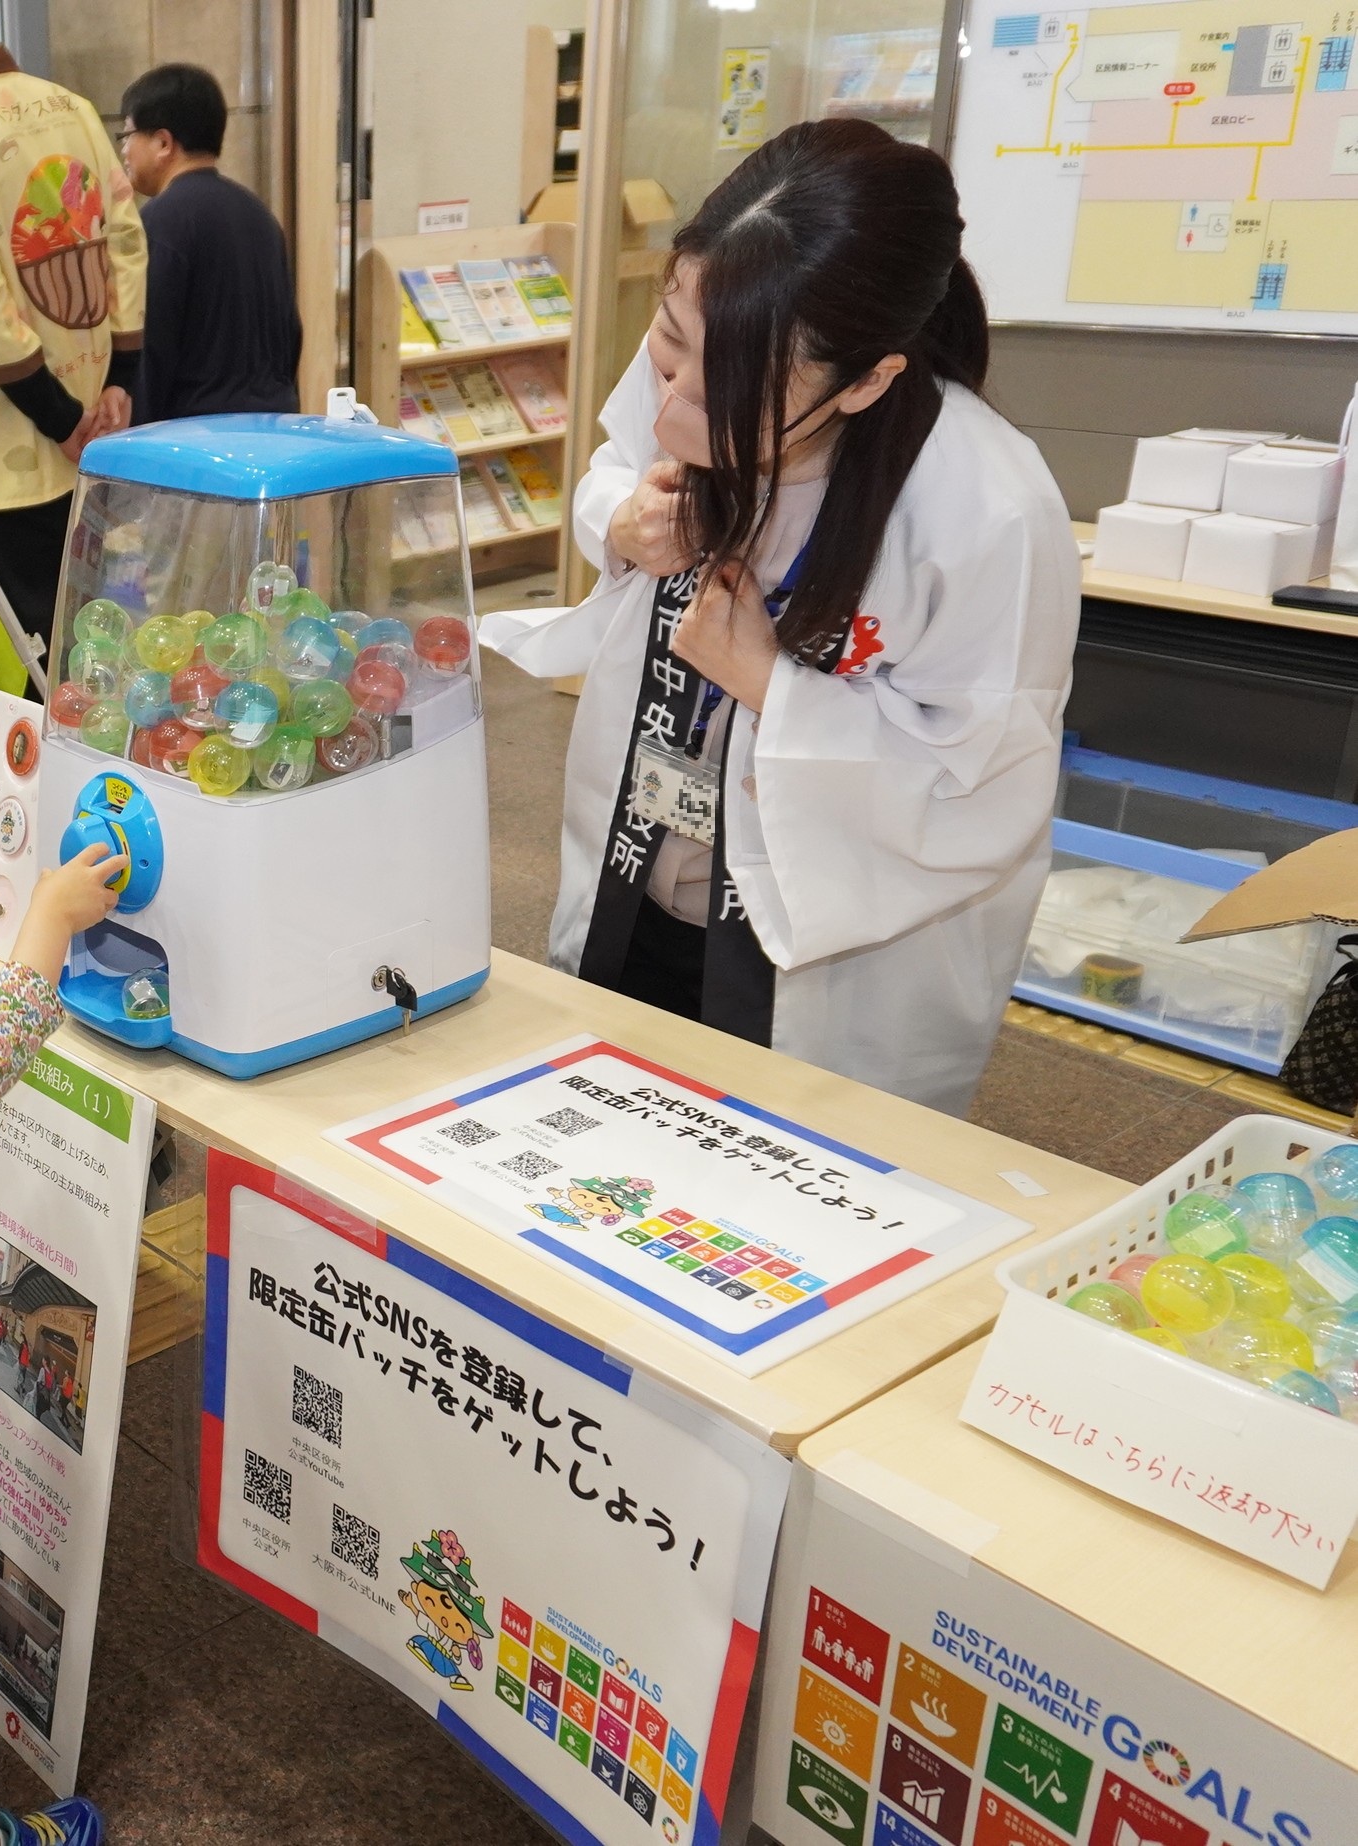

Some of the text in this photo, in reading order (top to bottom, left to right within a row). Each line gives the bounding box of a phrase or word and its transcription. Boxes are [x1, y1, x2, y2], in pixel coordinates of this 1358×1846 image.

[1095, 62, 1160, 73] 区民情報コーナー
[1190, 62, 1217, 72] 区役所
[1211, 115, 1255, 126] 区民ロビー
[558, 1073, 904, 1232] 限定缶バッチをゲットしよう！
[631, 1085, 850, 1193] 公式SNSを登録して、
[755, 1236, 806, 1264] GOALS
[313, 1261, 613, 1467] 公式SNSを登録して、
[249, 1266, 706, 1572] 限定缶バッチをゲットしよう！
[288, 1447, 345, 1489] 公式YouTube
[292, 1436, 341, 1474] 中央区役所
[988, 1383, 1336, 1553] カプセルはこちらに返却下さい
[242, 1517, 291, 1553] 中央区役所
[253, 1536, 279, 1559] 公式X
[311, 1552, 397, 1616] 大阪市公式LINE
[813, 1595, 820, 1611] 1
[547, 1606, 603, 1650] SUSTAINABLE
[546, 1614, 663, 1704] DEVELOPMENT GOALS
[903, 1653, 915, 1672] 2
[935, 1609, 1102, 1720] SUSTAINABLE
[805, 1675, 814, 1690] 7
[932, 1628, 1097, 1736] DEVELOPMENT
[1002, 1714, 1014, 1733] 3
[892, 1734, 902, 1751] 8
[795, 1749, 811, 1770] 13
[1102, 1714, 1312, 1846] GOALS
[1109, 1783, 1122, 1802] 4
[881, 1809, 896, 1831] 14
[986, 1798, 998, 1816] 9
